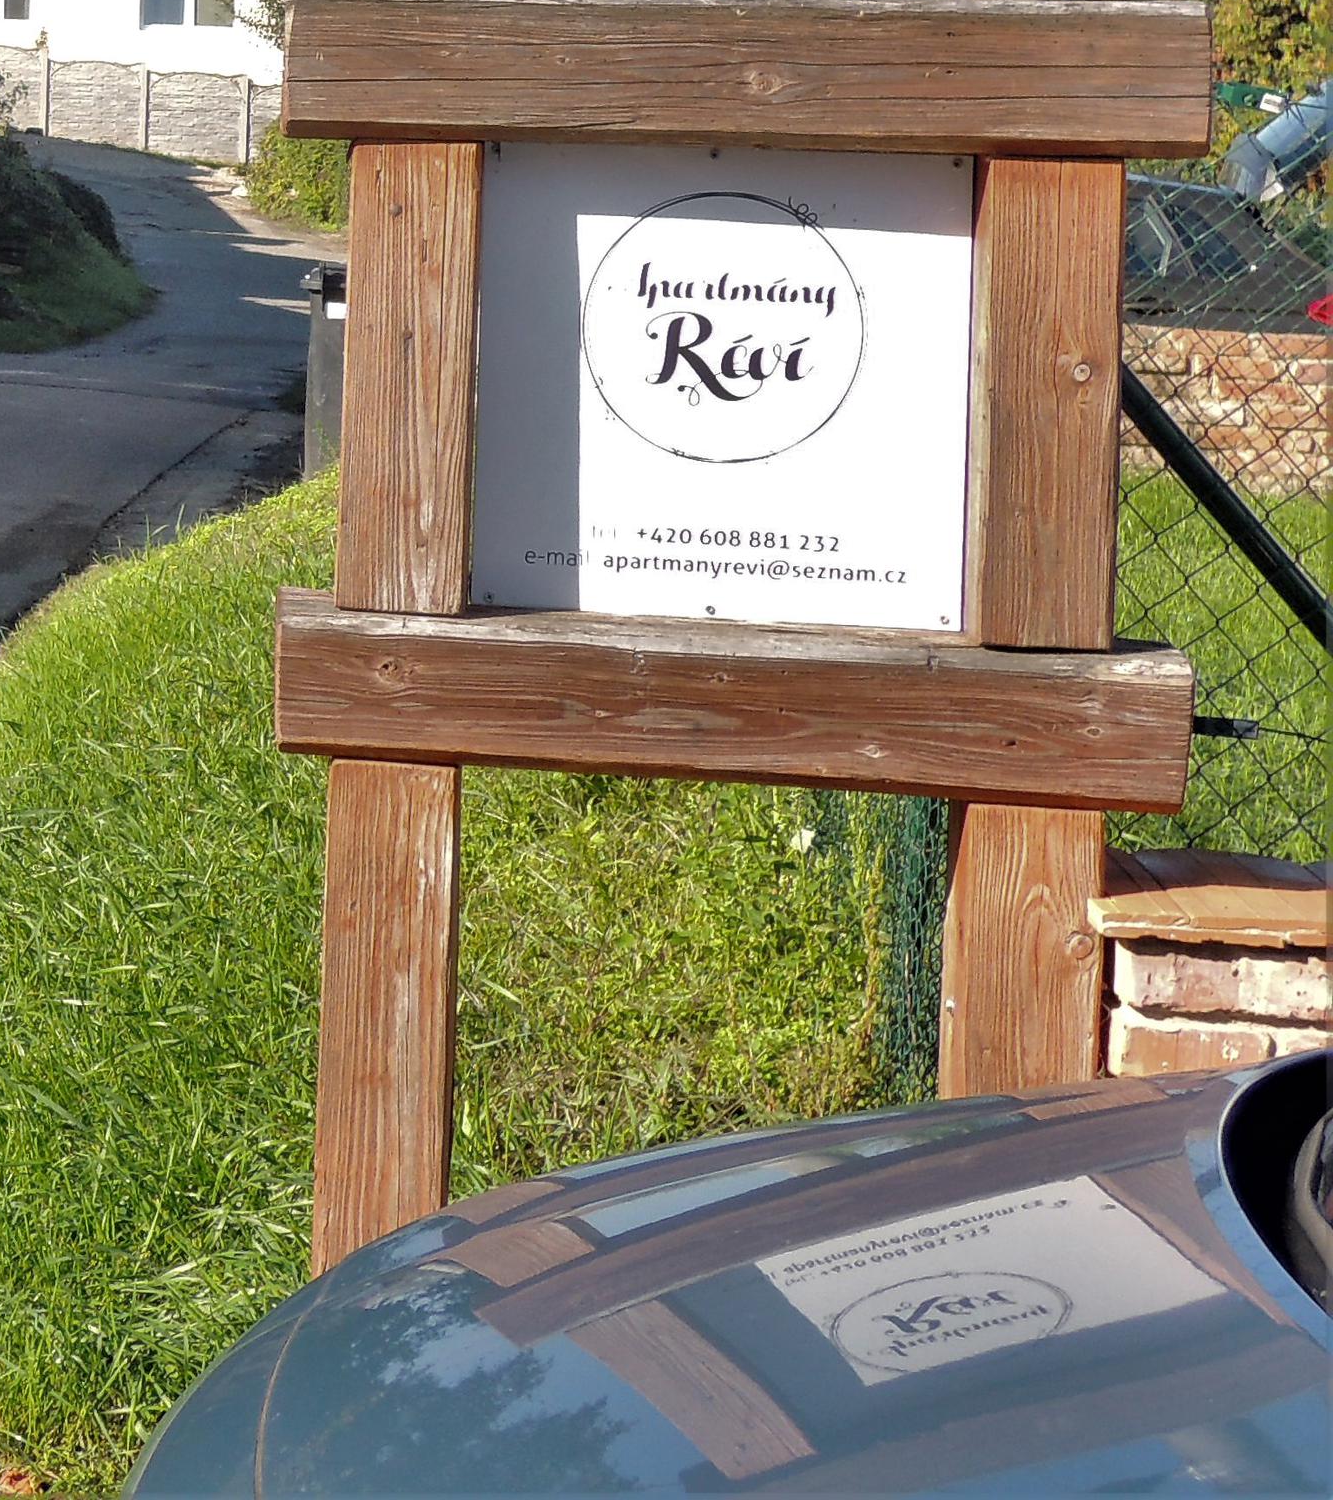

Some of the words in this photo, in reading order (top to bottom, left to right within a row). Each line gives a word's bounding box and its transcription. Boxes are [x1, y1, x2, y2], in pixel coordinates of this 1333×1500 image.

[637, 527, 692, 545] +420
[699, 528, 742, 547] 608
[749, 530, 790, 550] 881
[799, 534, 839, 553] 232
[603, 554, 907, 584] apartmanyrevi@seznam.cz
